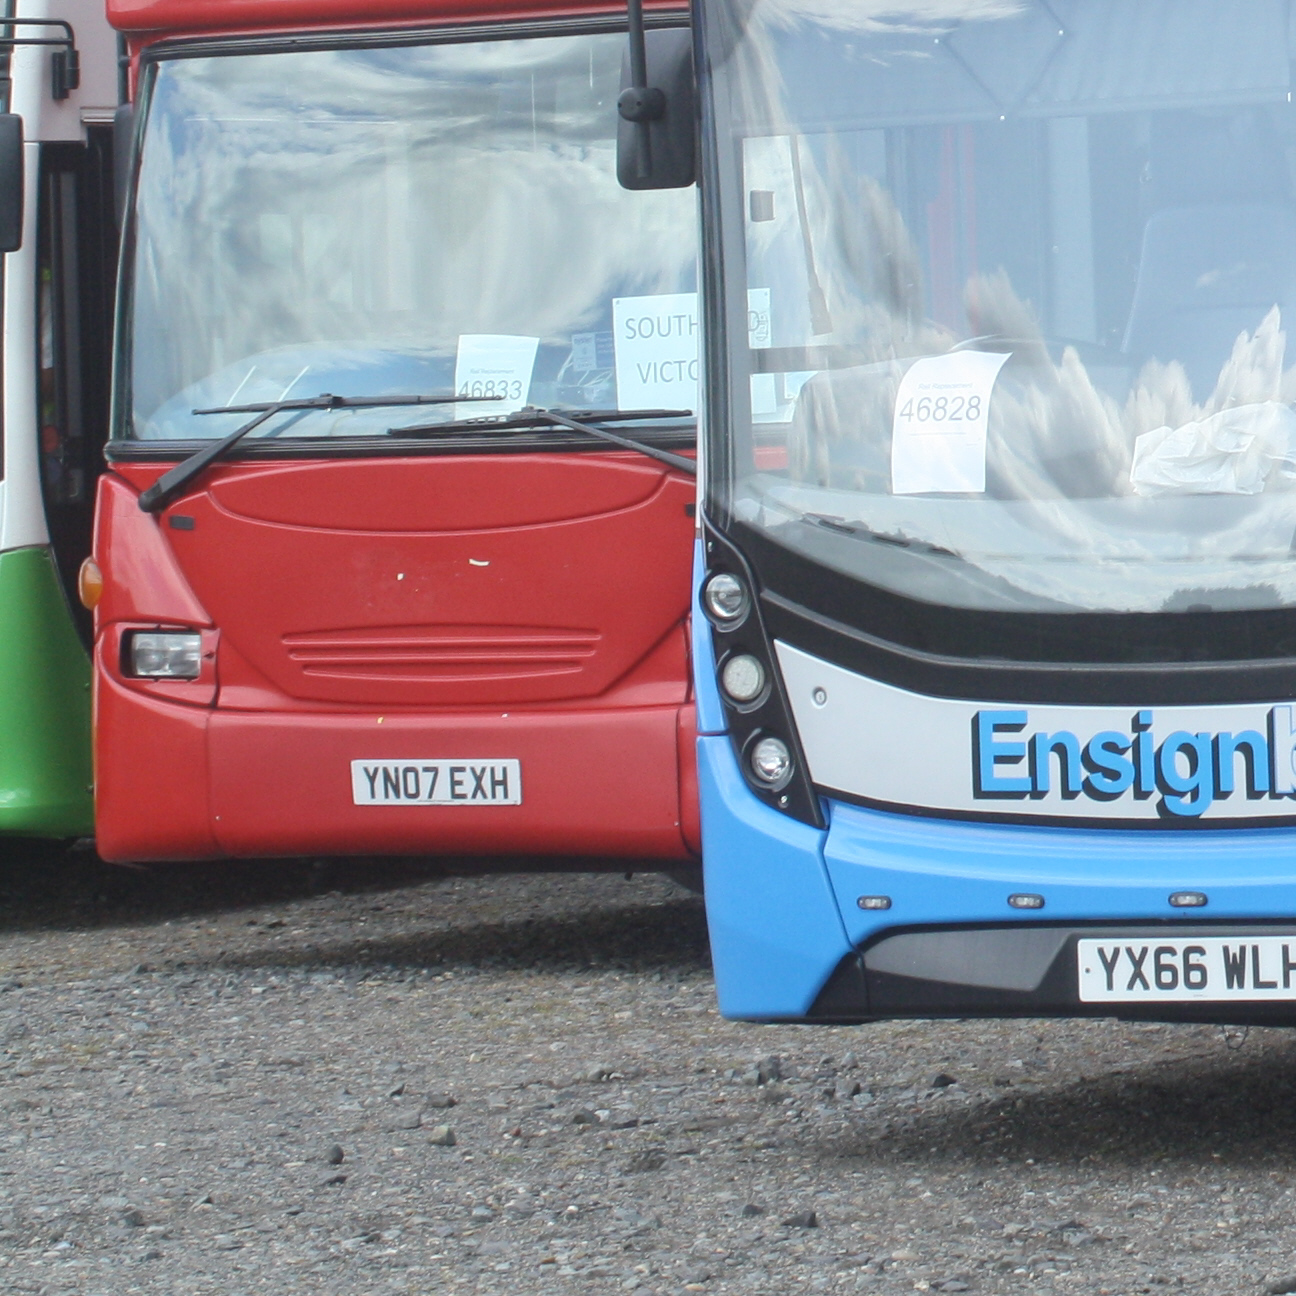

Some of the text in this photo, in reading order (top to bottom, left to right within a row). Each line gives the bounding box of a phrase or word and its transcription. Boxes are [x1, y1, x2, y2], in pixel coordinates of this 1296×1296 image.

[458, 380, 522, 400] 46833
[899, 395, 981, 422] 46828
[363, 766, 509, 800] YN07 EXH
[1097, 945, 1208, 992] YX66
